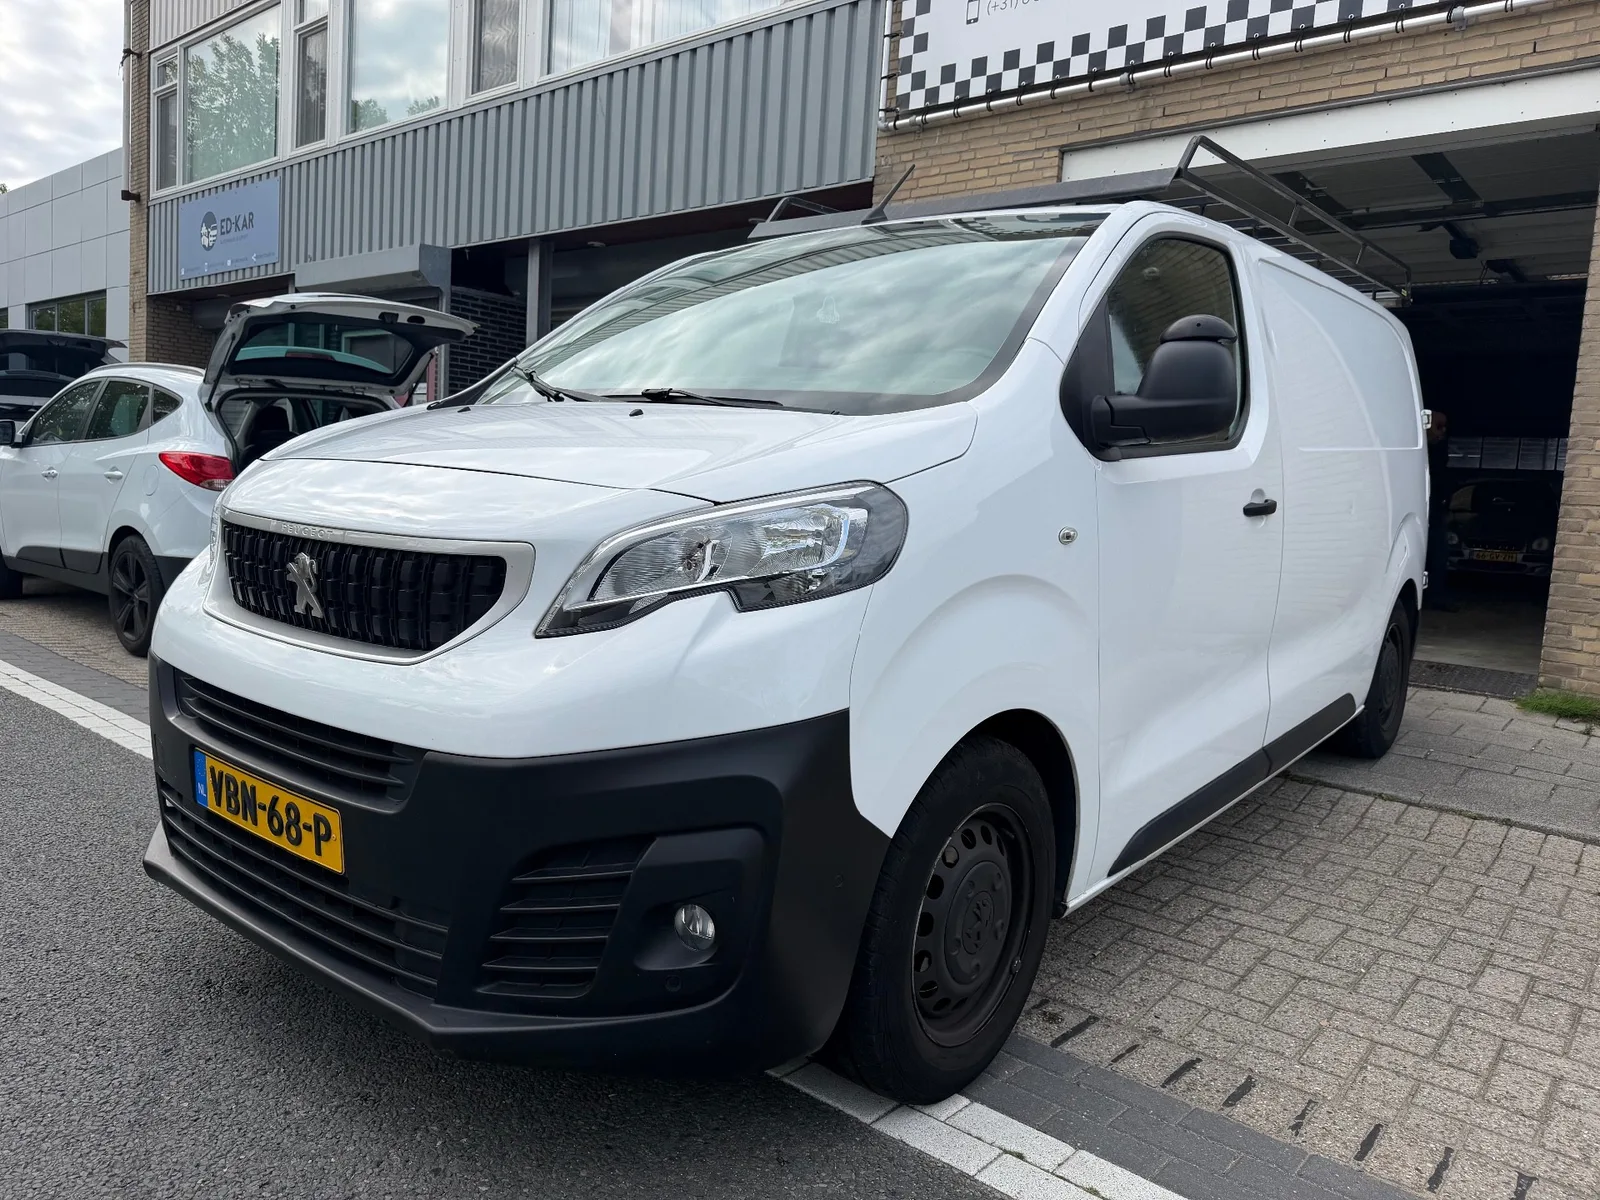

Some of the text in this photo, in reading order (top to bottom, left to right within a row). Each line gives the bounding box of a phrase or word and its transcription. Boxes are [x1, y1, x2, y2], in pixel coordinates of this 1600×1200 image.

[282, 523, 333, 539] PEUGEOT
[197, 782, 206, 797] NL
[209, 765, 332, 857] VBN-68-P
